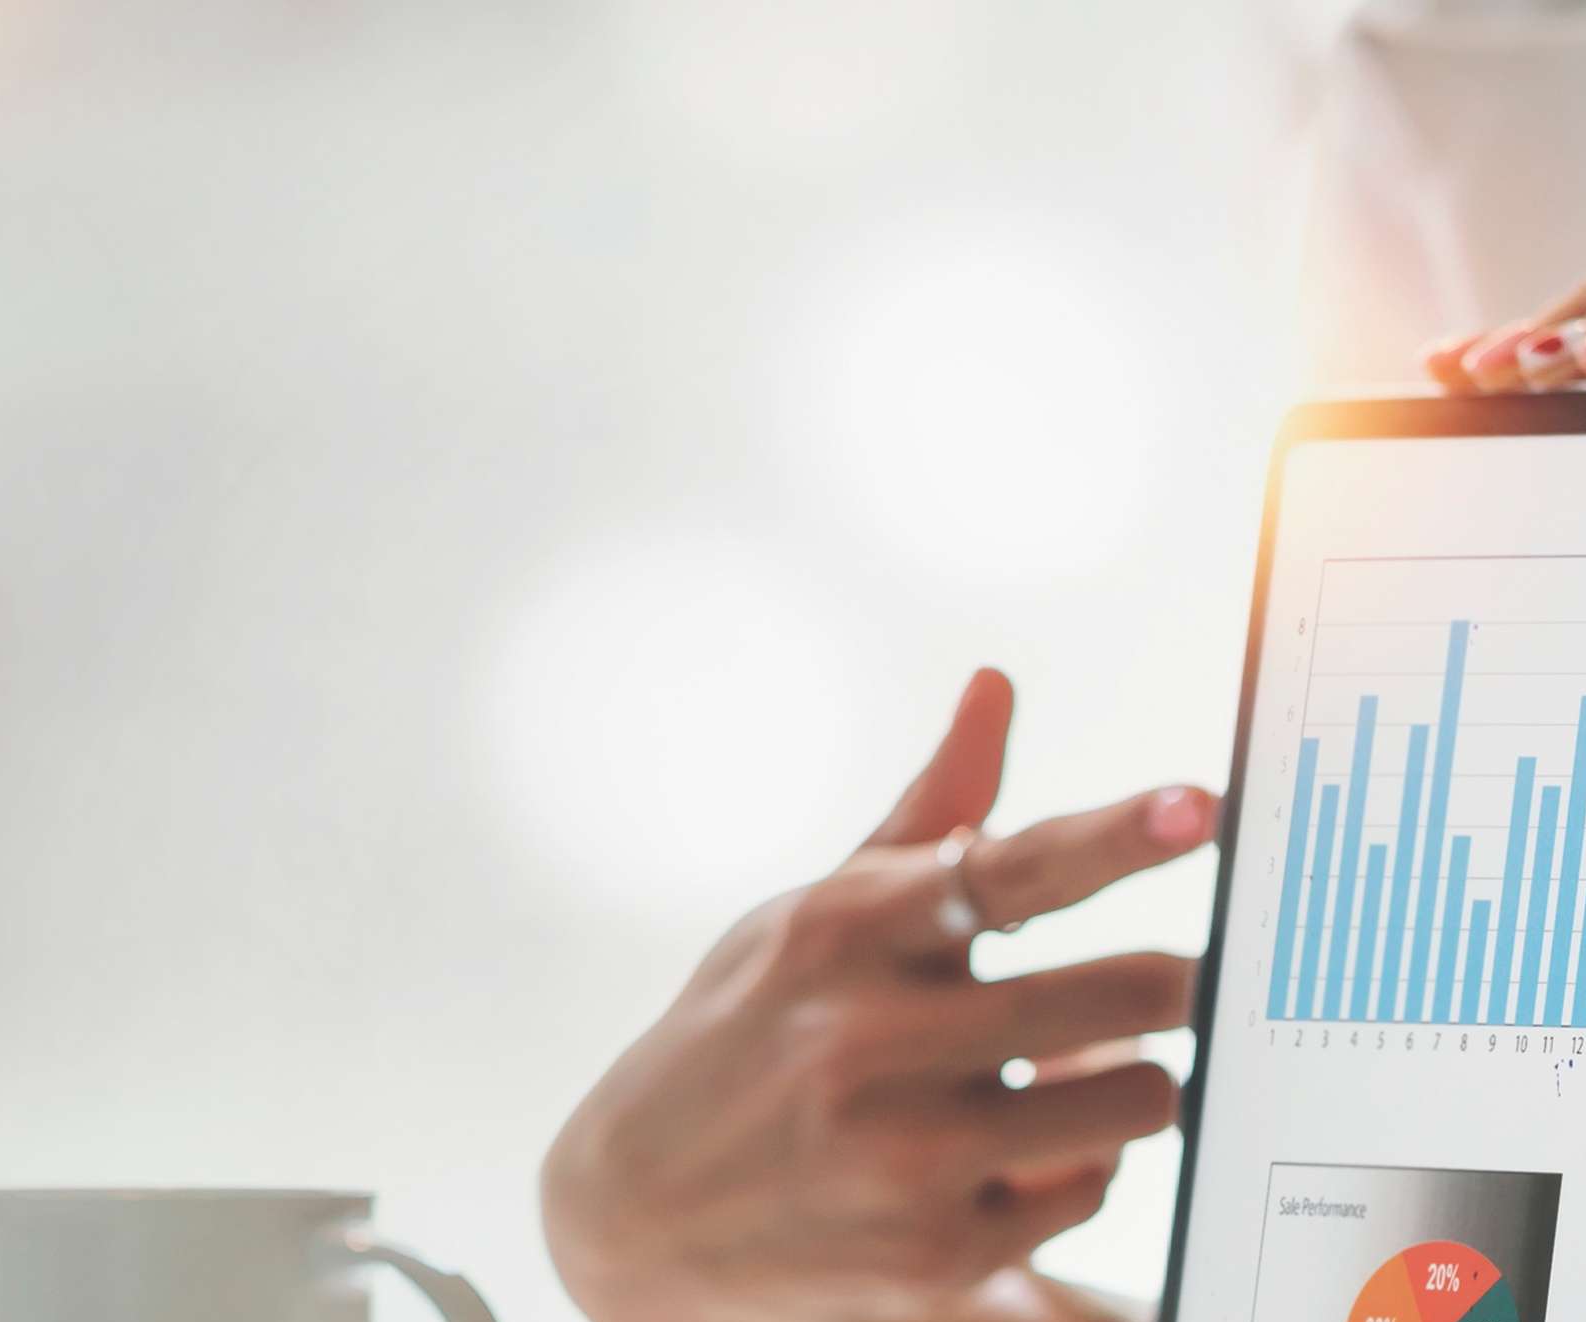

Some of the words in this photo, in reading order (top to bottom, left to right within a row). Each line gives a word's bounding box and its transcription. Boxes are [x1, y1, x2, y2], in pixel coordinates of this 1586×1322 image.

[1269, 1029, 1275, 1046] 1
[1295, 1030, 1303, 1047] 2
[1321, 1030, 1329, 1048] 3
[1350, 1032, 1358, 1047] 4
[1377, 1032, 1385, 1049] 5
[1405, 1032, 1414, 1050] 6
[1432, 1033, 1441, 1050] 7
[1460, 1034, 1468, 1051] 8
[1488, 1034, 1496, 1052] 9
[1515, 1035, 1528, 1053] 10
[1542, 1036, 1554, 1053] 11
[1571, 1037, 1583, 1055] 12
[1279, 1196, 1300, 1216] Sale
[1301, 1197, 1367, 1219] Performance
[1426, 1263, 1460, 1292] 20%
